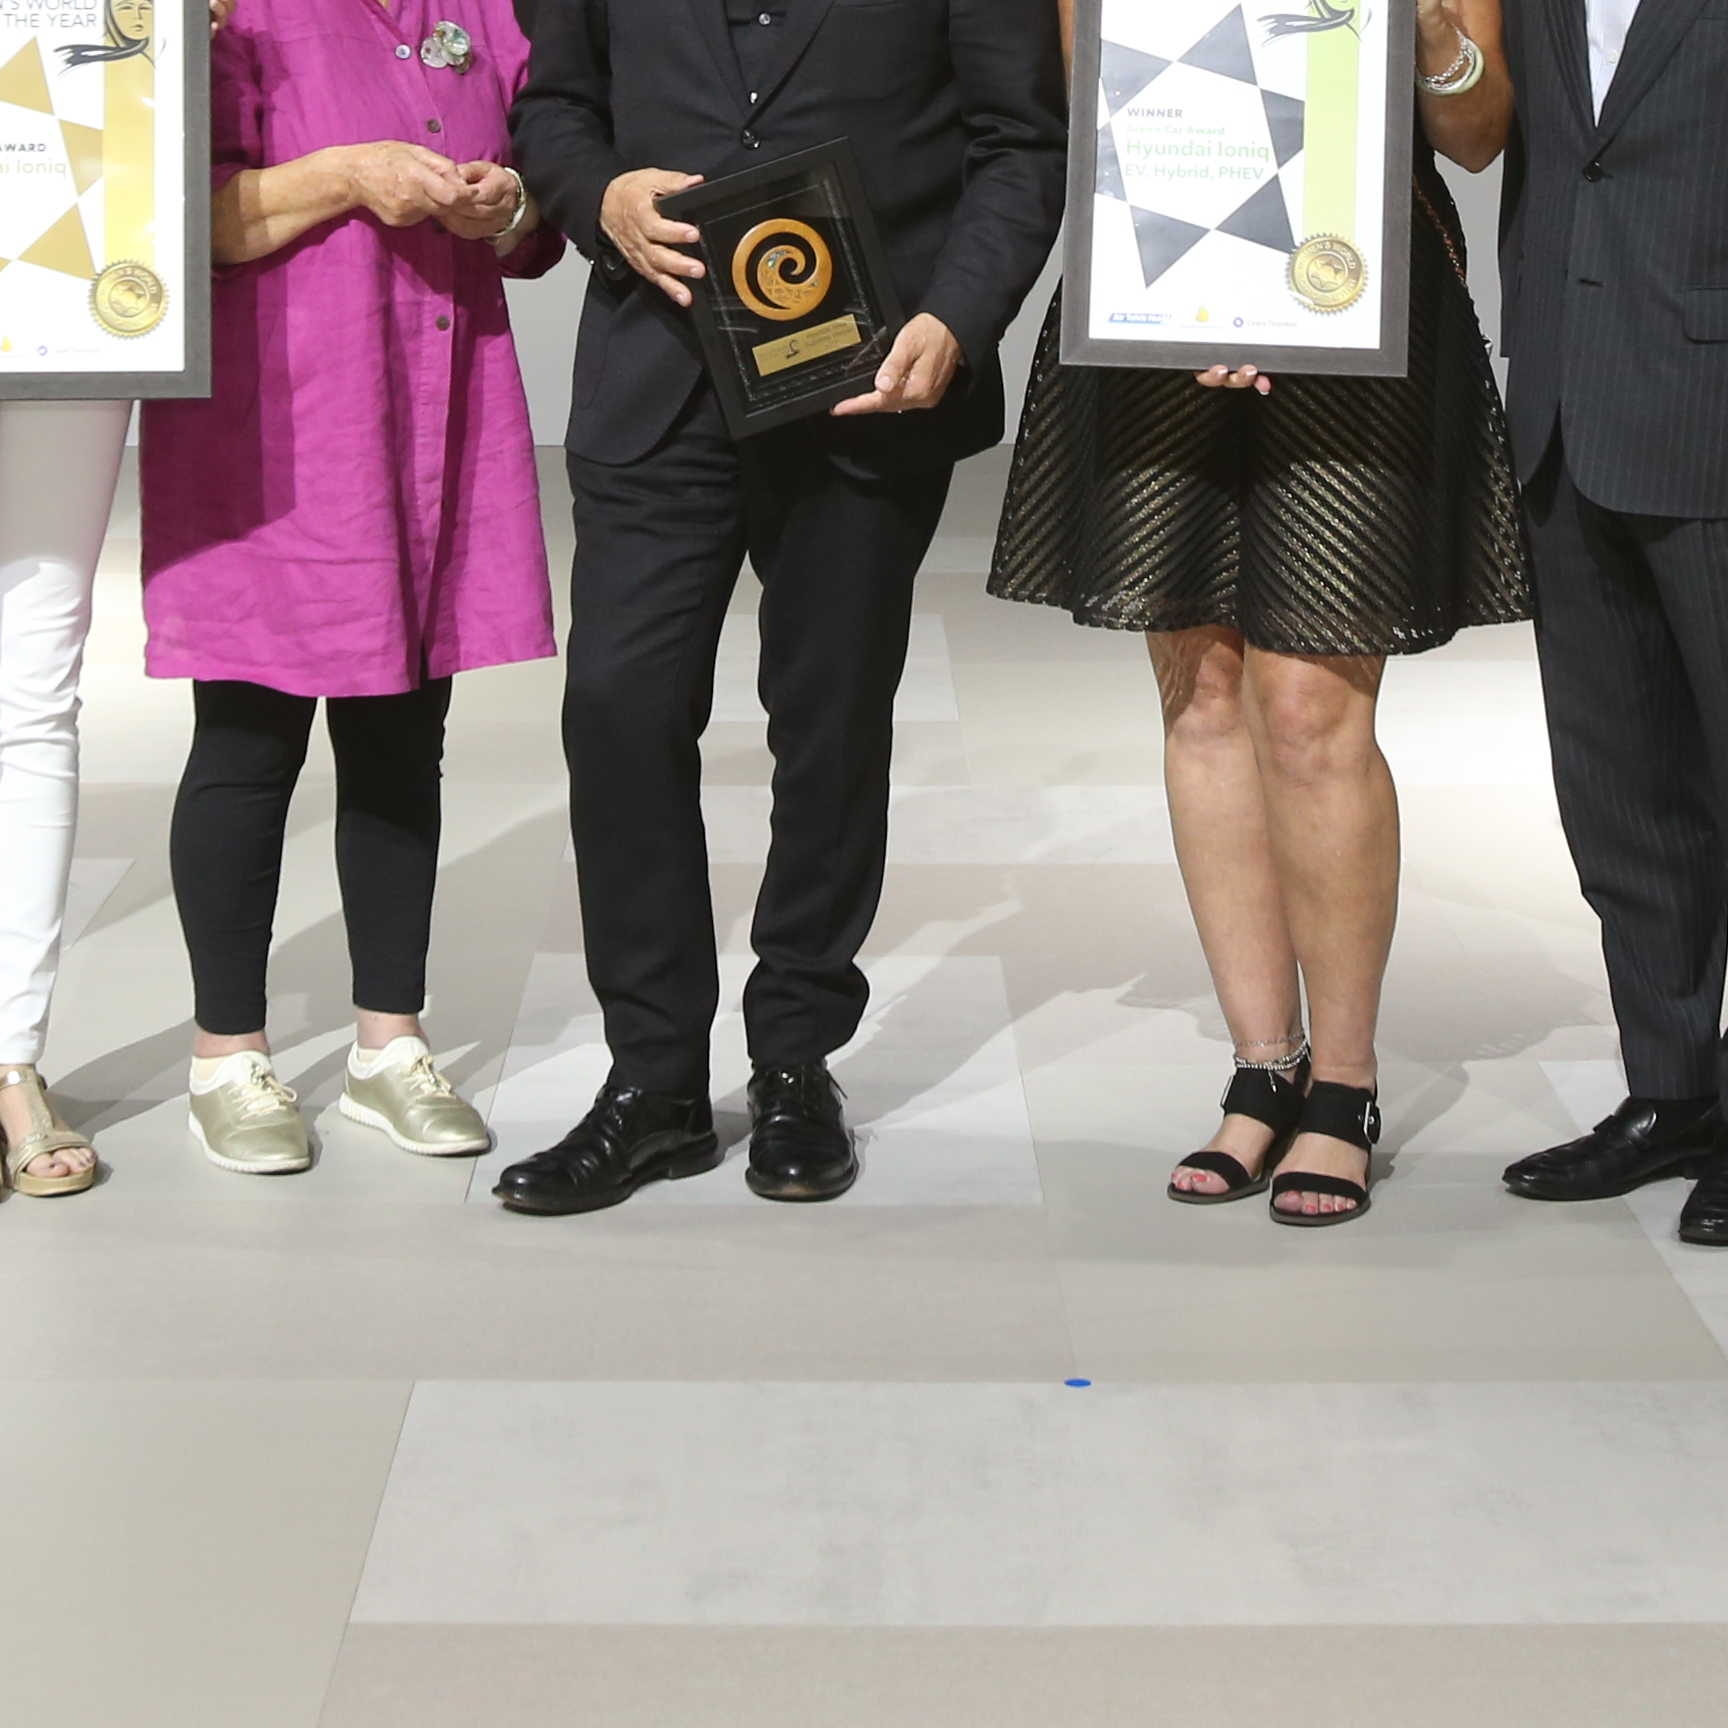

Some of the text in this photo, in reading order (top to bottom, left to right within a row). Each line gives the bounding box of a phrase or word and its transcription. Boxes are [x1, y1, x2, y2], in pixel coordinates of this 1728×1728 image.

[3, 13, 40, 28] THE
[46, 13, 97, 28] YEAR
[1127, 108, 1183, 119] WINNER
[1126, 139, 1270, 163] Hyundai Ioniq
[16, 157, 66, 180] Ioniq
[1218, 164, 1265, 180] PHEV
